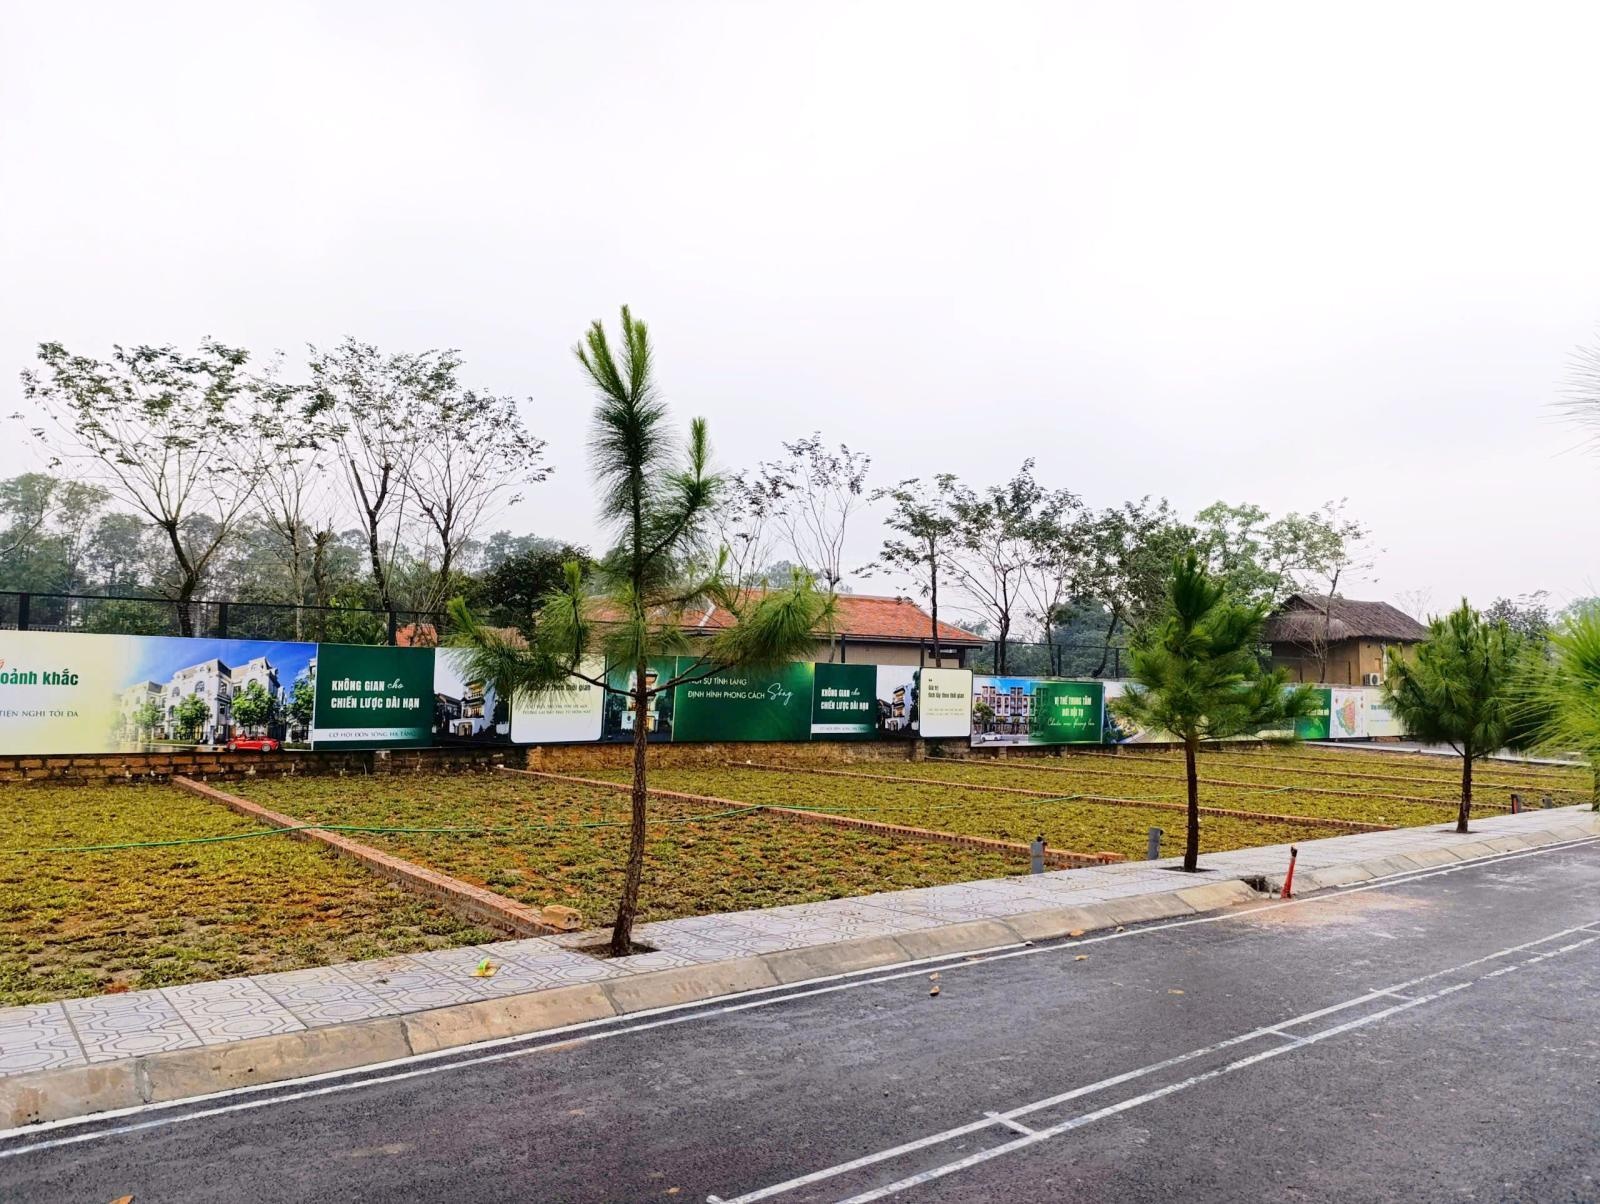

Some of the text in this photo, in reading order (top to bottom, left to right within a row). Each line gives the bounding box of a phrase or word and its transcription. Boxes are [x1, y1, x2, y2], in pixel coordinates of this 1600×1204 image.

[42, 668, 79, 686] khắc
[703, 677, 713, 685] SỰ
[331, 678, 404, 692] KHÔNG GIAN cho
[687, 690, 765, 699] ĐỊNH HÌNH PHONG CÁCH
[330, 695, 420, 711] CHIẾN LƯỢC DÀI HẠN
